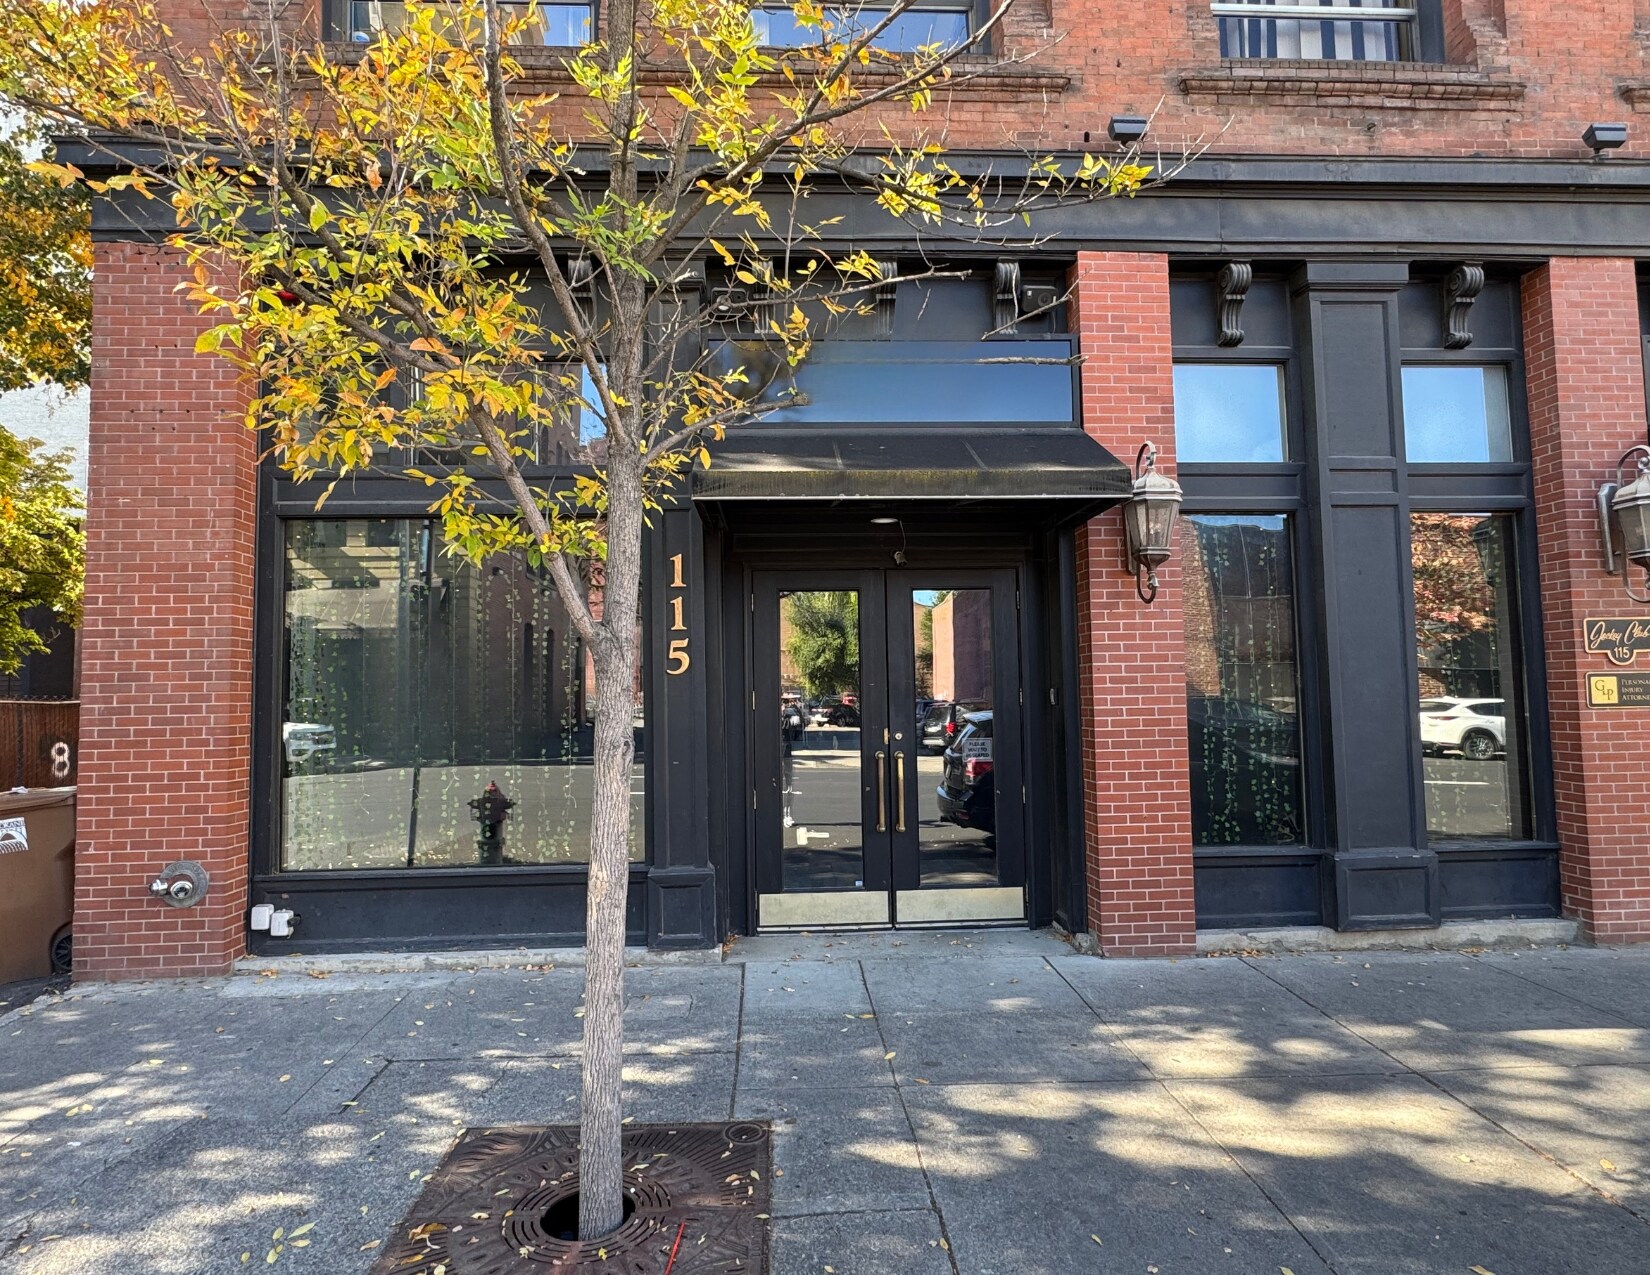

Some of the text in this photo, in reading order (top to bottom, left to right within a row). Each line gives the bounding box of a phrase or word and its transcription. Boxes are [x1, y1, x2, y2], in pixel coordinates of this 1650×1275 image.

[666, 553, 690, 675] 115
[1624, 621, 1650, 645] Club
[1613, 646, 1631, 659] 115
[51, 741, 70, 779] 8
